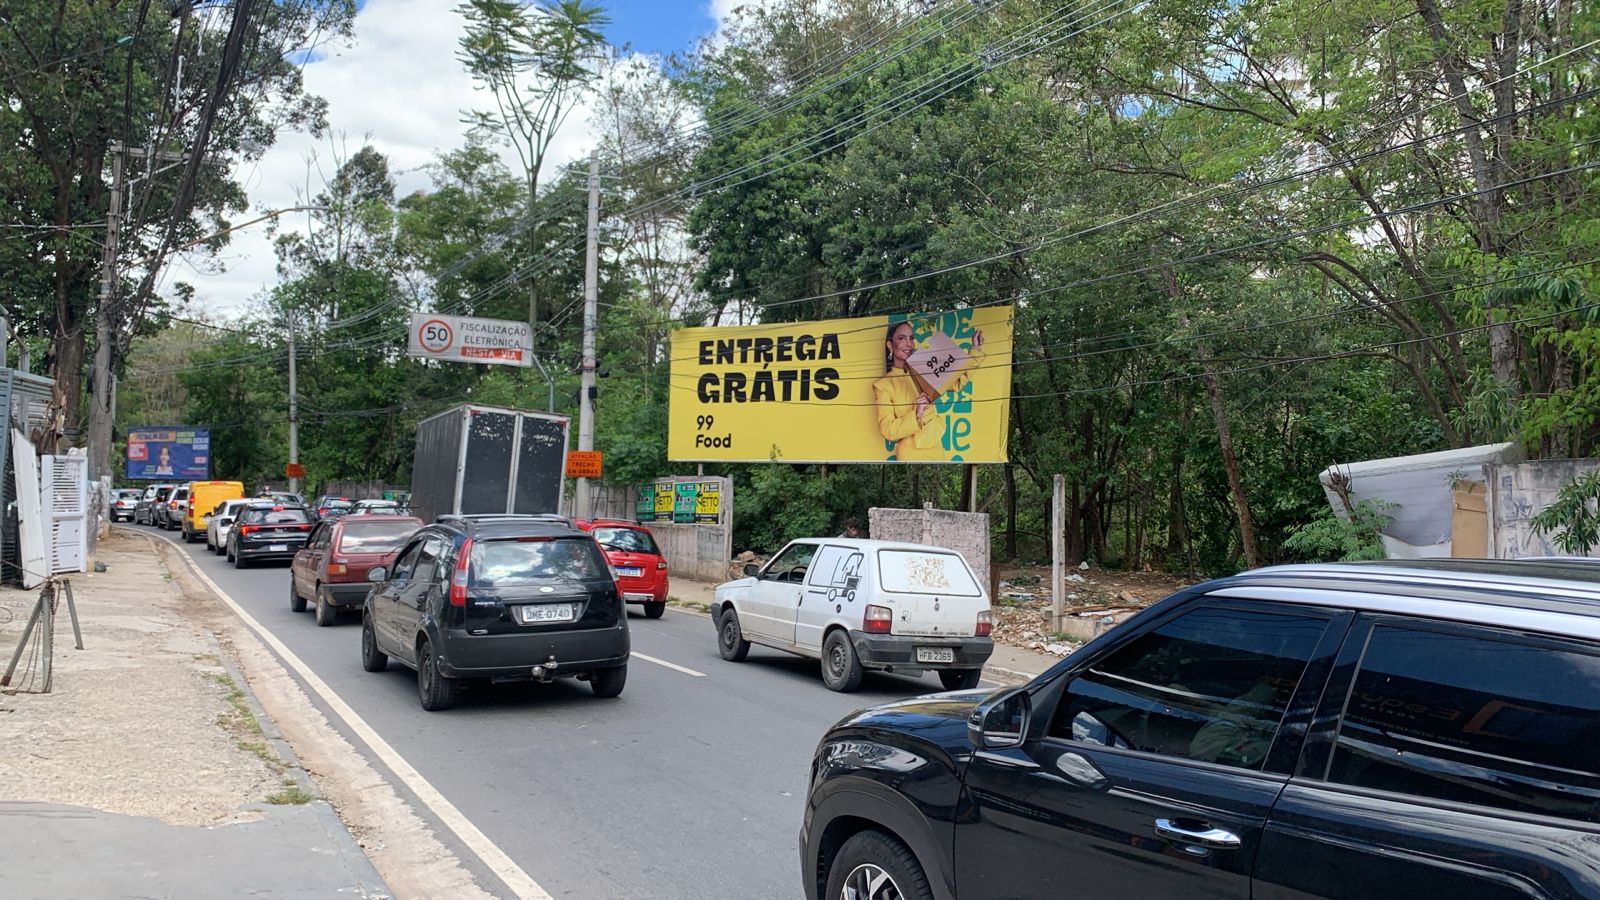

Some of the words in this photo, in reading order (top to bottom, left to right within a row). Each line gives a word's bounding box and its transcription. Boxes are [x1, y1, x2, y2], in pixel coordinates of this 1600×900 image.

[426, 327, 448, 342] 50
[460, 322, 527, 337] FISCALIZAÇÃO
[464, 335, 520, 348] ELETRÔNICA
[698, 333, 841, 365] ENTREGA
[466, 348, 495, 358] NESTA
[501, 350, 516, 360] VIA
[926, 356, 938, 369] 99
[933, 354, 956, 378] Food
[697, 363, 840, 404] GRÁTIS
[696, 414, 714, 431] 99
[695, 433, 732, 449] Food
[934, 651, 952, 661] 2369
